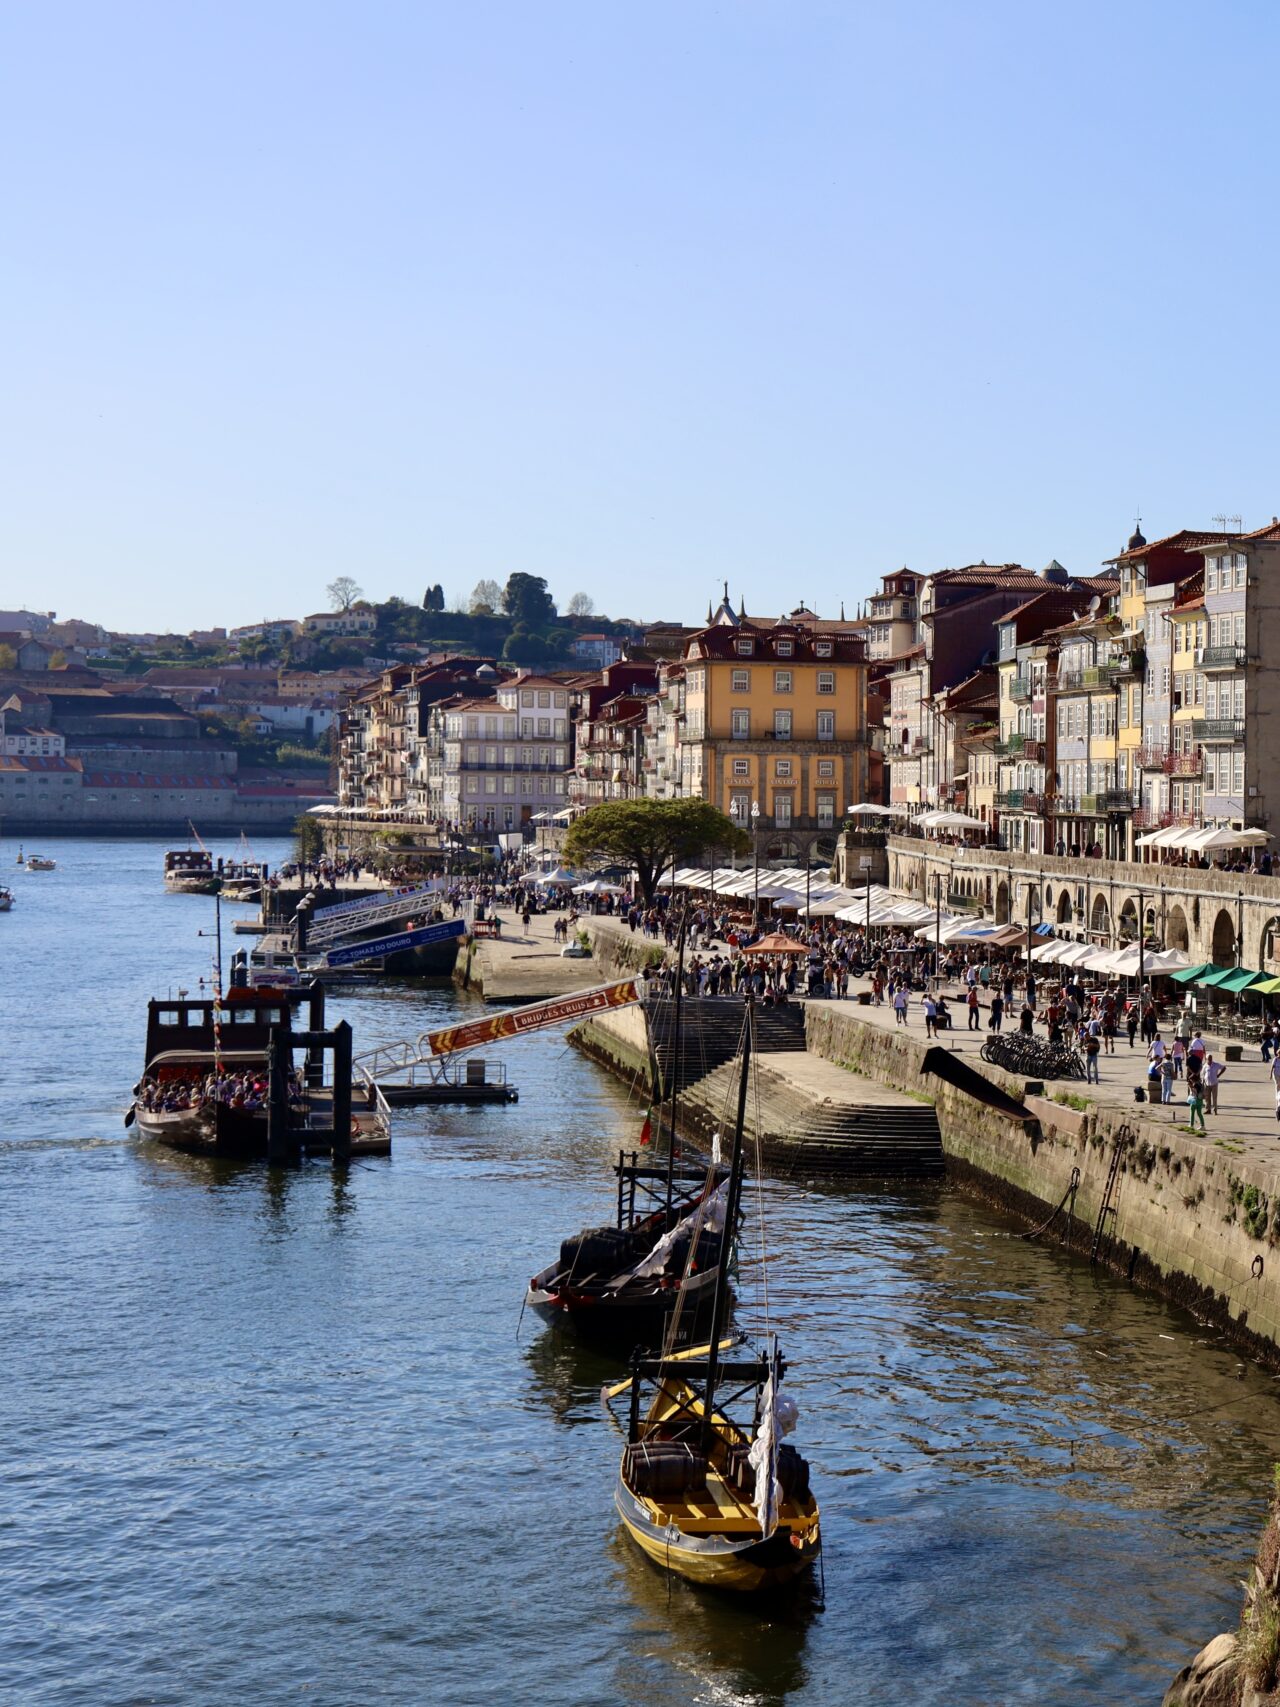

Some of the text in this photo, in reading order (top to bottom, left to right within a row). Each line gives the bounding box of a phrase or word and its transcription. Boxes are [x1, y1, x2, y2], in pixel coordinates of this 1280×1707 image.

[350, 937, 412, 957] TOMAZ DO DOURO
[521, 1000, 591, 1026] BRIDGES CRUISE
